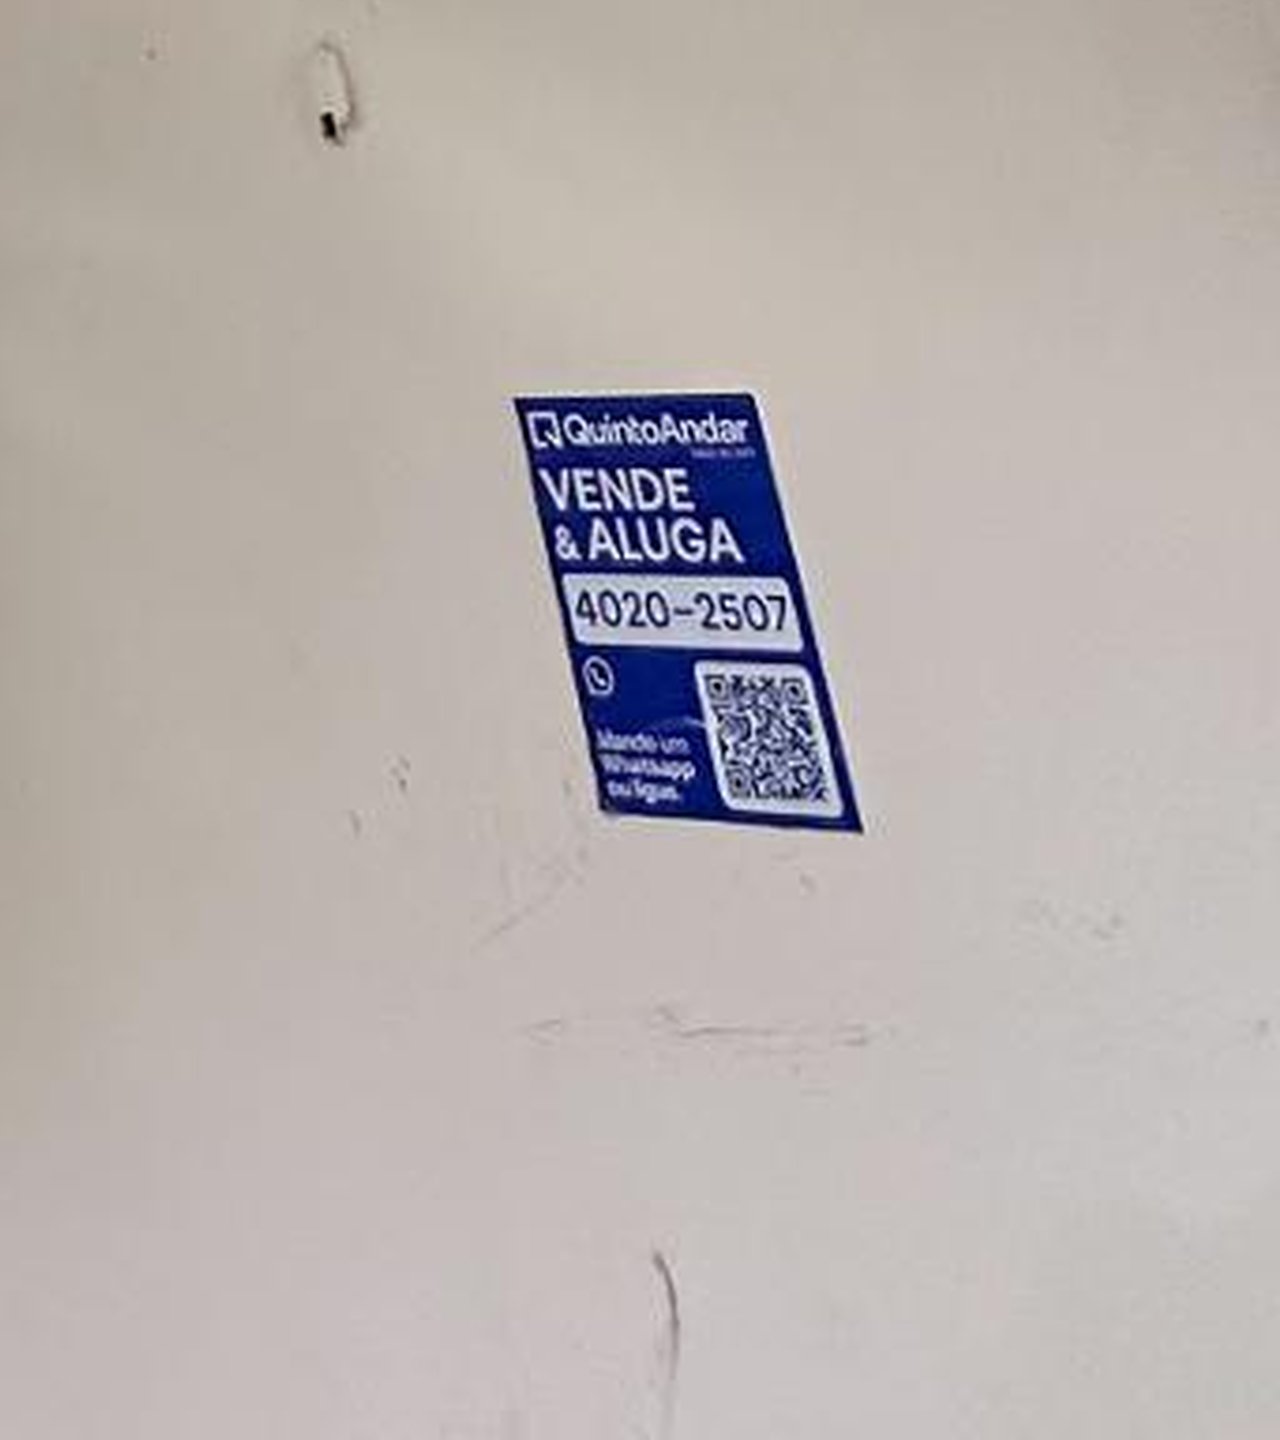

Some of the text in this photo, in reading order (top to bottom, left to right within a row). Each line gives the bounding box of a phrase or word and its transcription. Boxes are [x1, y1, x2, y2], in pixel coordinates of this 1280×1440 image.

[562, 412, 749, 446] QuintoAndar
[538, 468, 695, 512] VENDE
[555, 517, 746, 563] & ALUGA
[576, 589, 787, 631] 4020-2507
